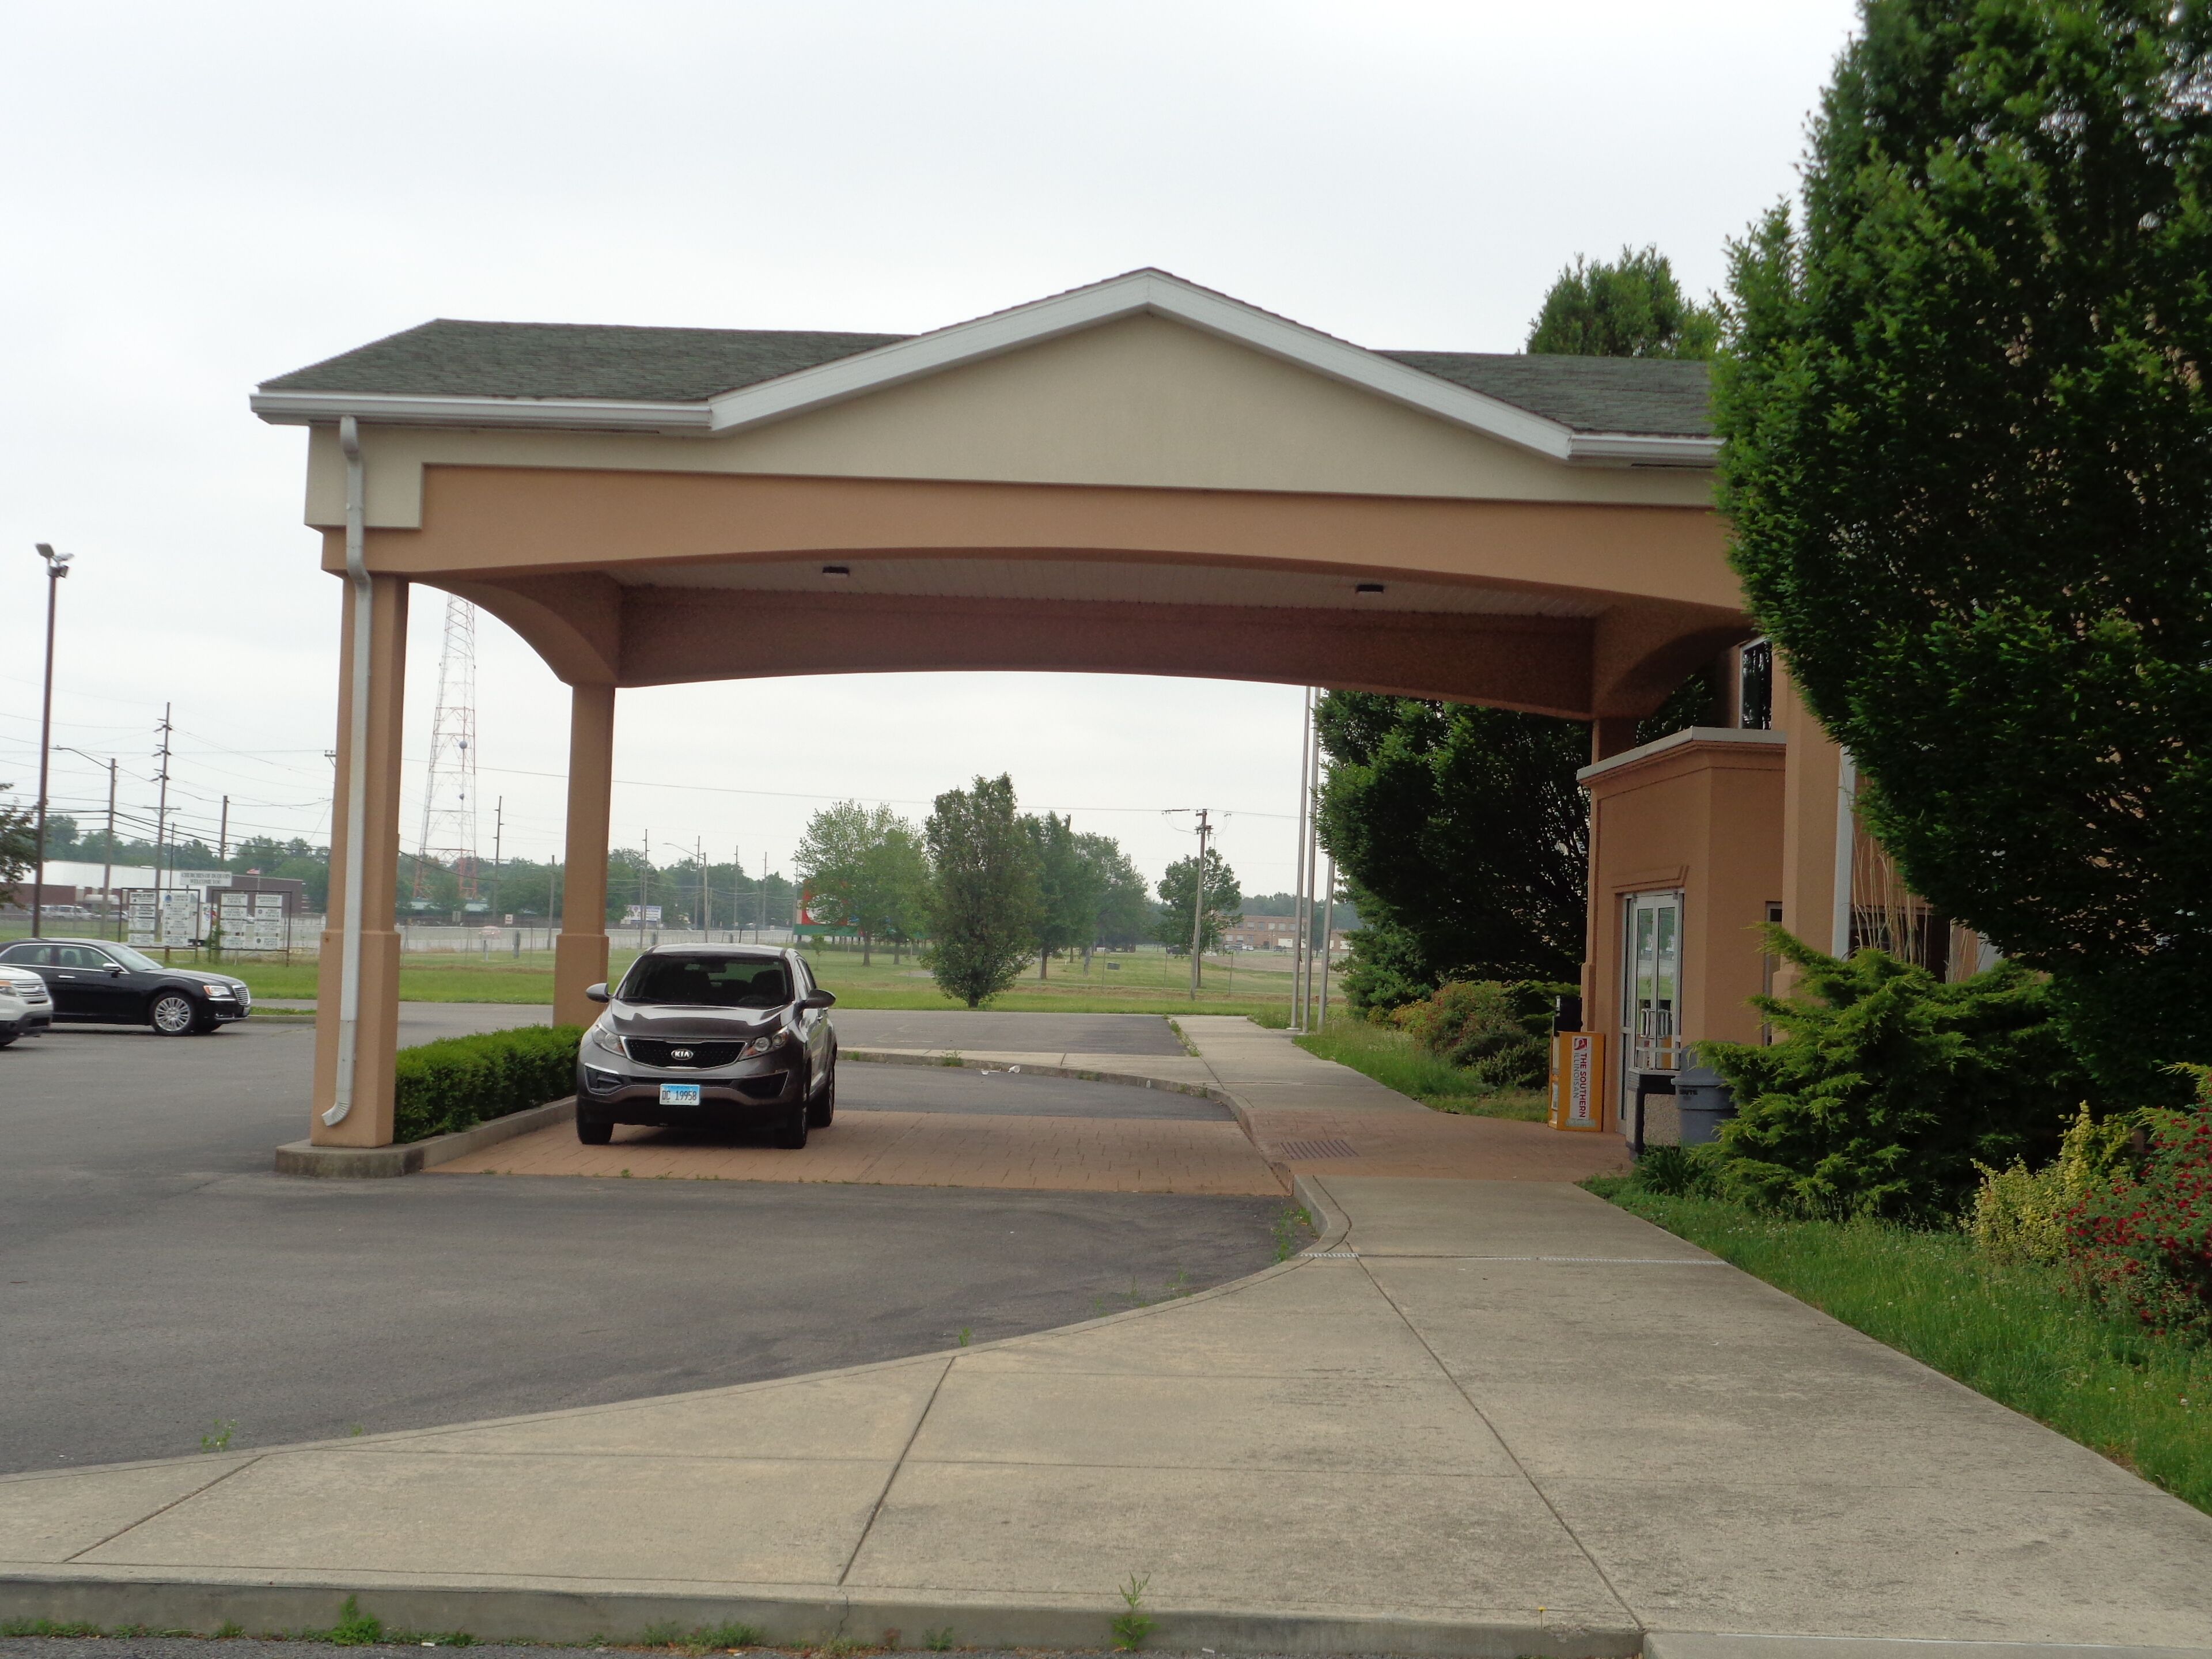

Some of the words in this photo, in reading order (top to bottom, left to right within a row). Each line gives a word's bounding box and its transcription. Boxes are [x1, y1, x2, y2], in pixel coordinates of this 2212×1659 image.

[662, 1090, 671, 1100] DC
[675, 1090, 696, 1101] 19958
[1579, 1071, 1587, 1118] SOUTHERN
